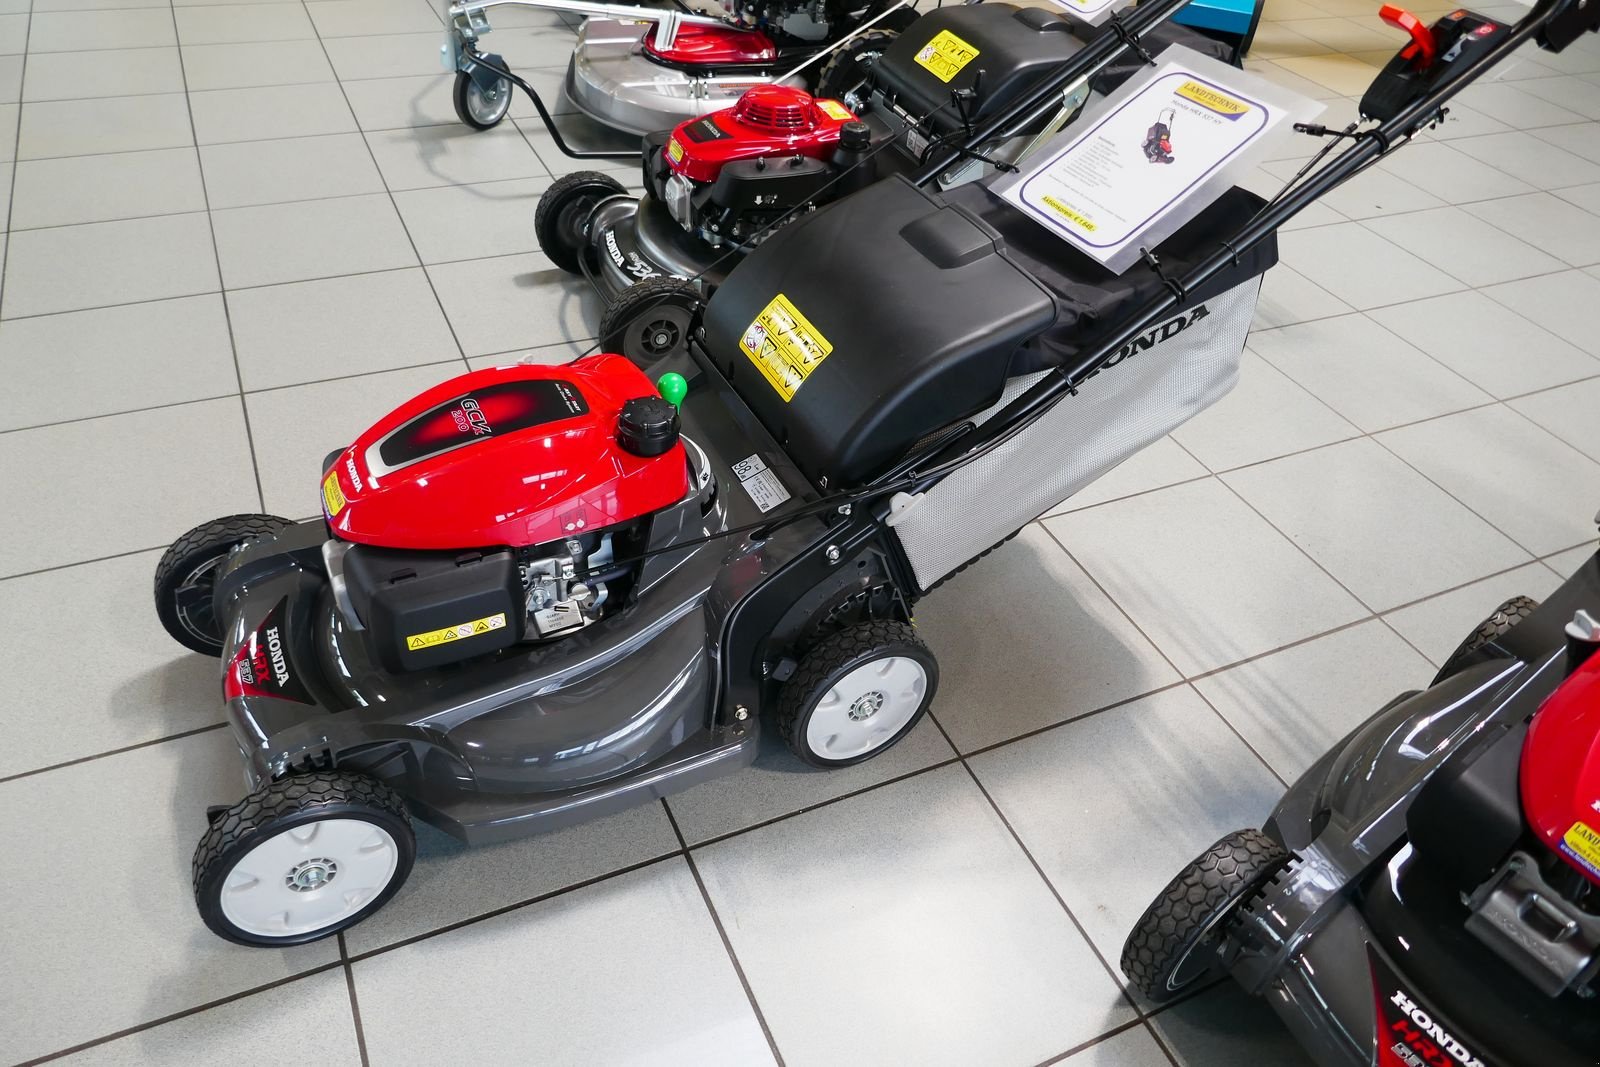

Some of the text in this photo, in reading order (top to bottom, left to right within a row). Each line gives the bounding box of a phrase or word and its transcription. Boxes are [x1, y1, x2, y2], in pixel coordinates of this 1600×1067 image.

[1183, 82, 1240, 112] LANDTECHNIK
[701, 120, 721, 138] HONDA
[605, 230, 625, 268] HONDA
[1073, 304, 1211, 387] ONDA
[451, 410, 469, 431] 200
[346, 458, 363, 493] HONDA
[734, 460, 752, 475] 98
[239, 659, 254, 684] 537
[266, 626, 289, 688] HONDA
